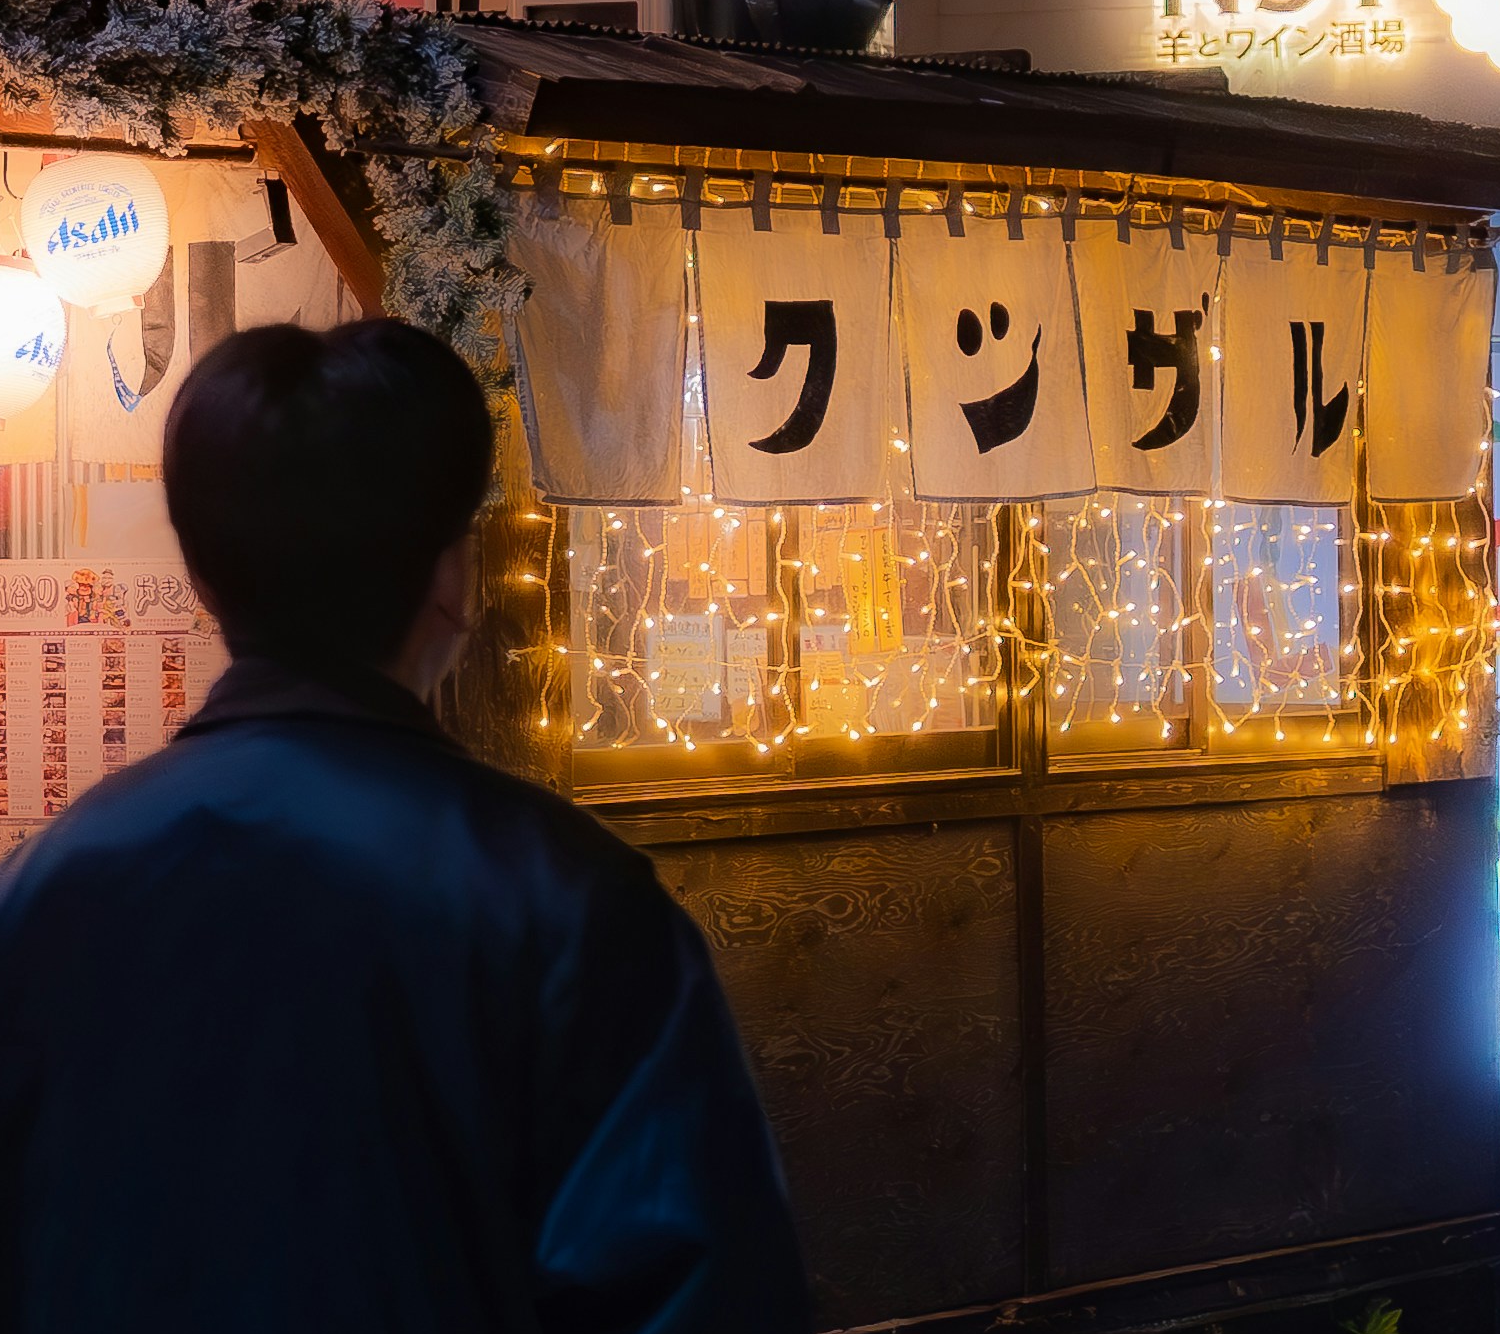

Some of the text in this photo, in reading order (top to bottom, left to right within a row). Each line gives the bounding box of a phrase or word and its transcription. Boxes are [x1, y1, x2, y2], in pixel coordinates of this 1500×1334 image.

[1156, 19, 1406, 63] 羊とワイン酒場
[46, 198, 140, 255] Asahi
